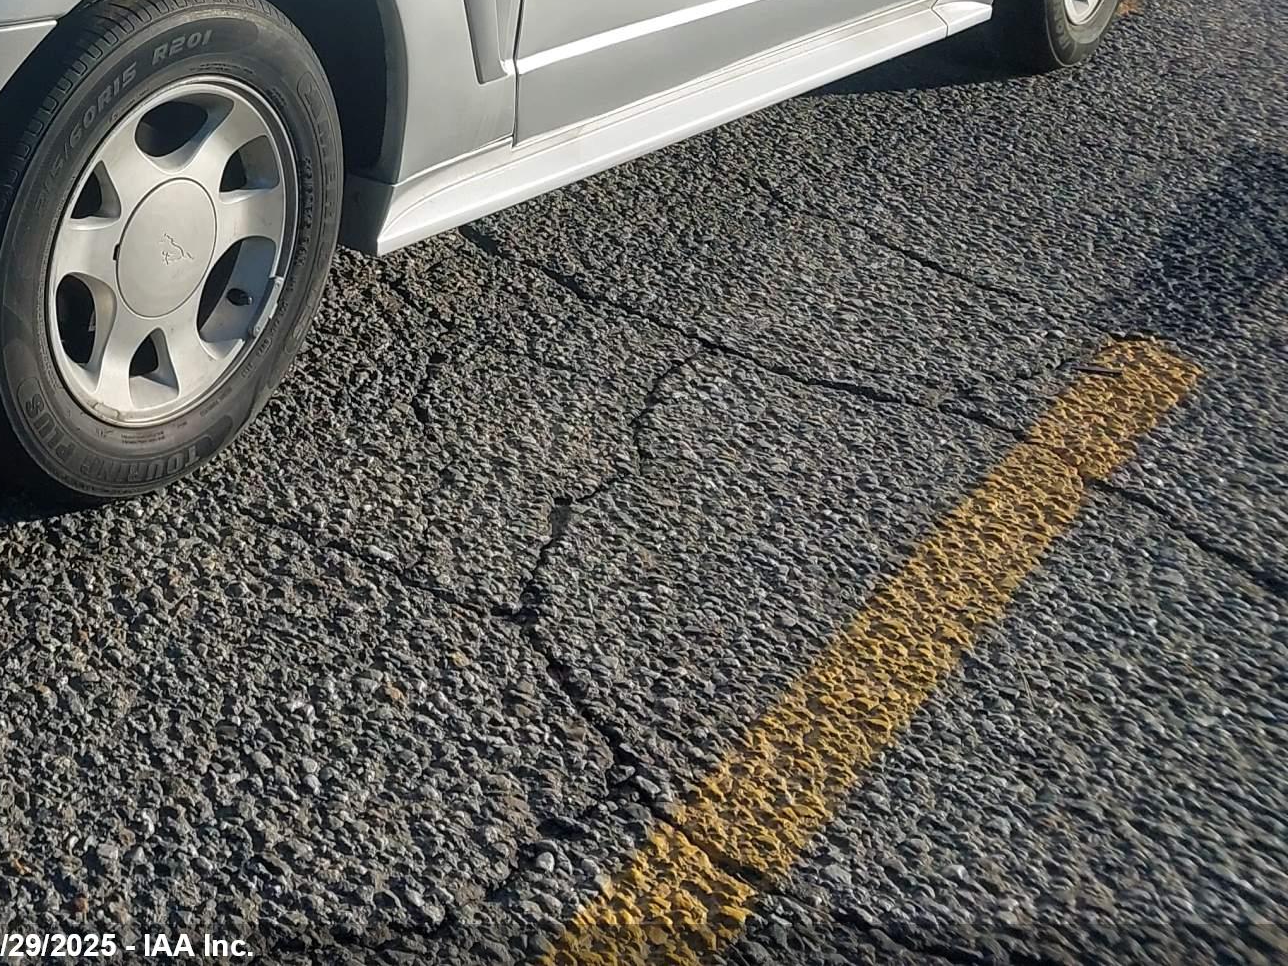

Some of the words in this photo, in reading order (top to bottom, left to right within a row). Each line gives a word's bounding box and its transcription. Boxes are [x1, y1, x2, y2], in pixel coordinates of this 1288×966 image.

[151, 29, 212, 66] R201
[25, 392, 75, 460] PLUS
[79, 444, 201, 483] TOURING
